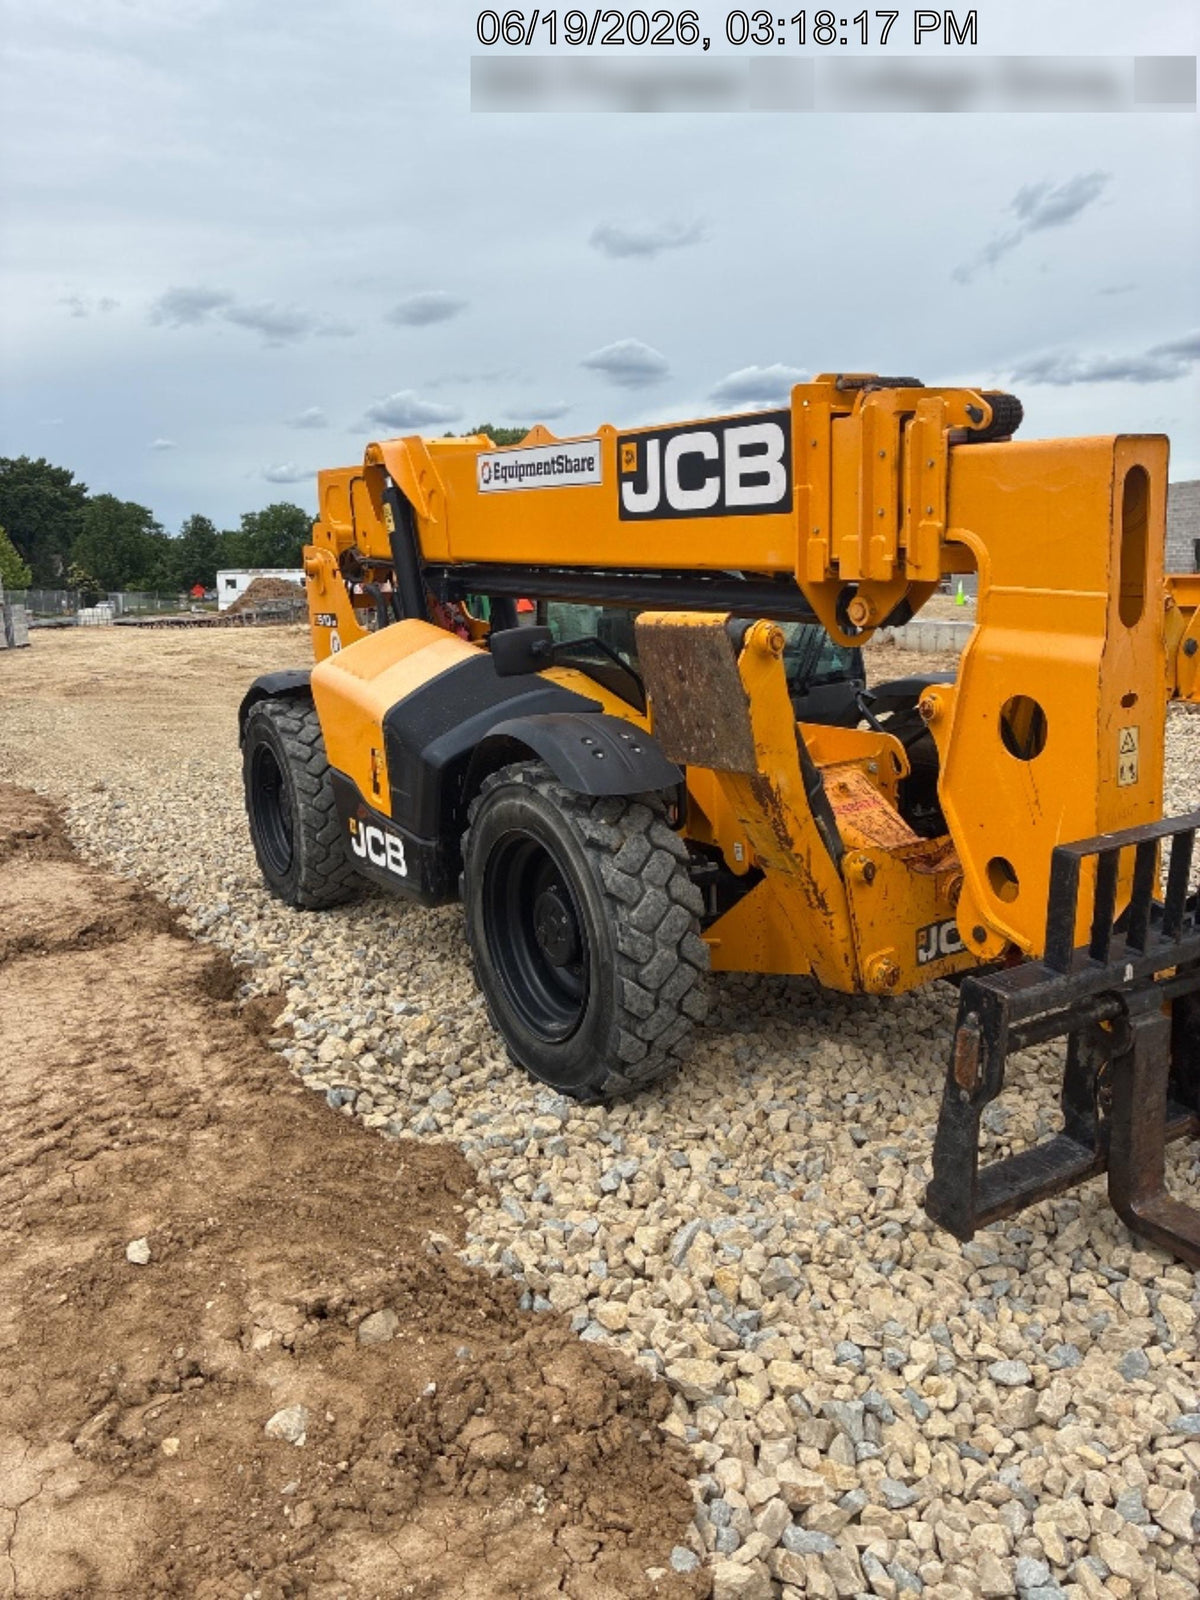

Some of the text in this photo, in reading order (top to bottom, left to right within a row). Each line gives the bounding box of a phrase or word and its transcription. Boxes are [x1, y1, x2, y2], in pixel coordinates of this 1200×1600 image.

[493, 453, 595, 484] EquipmentShare
[622, 422, 787, 512] JCB
[351, 821, 408, 878] JCB
[918, 920, 967, 963] JC
